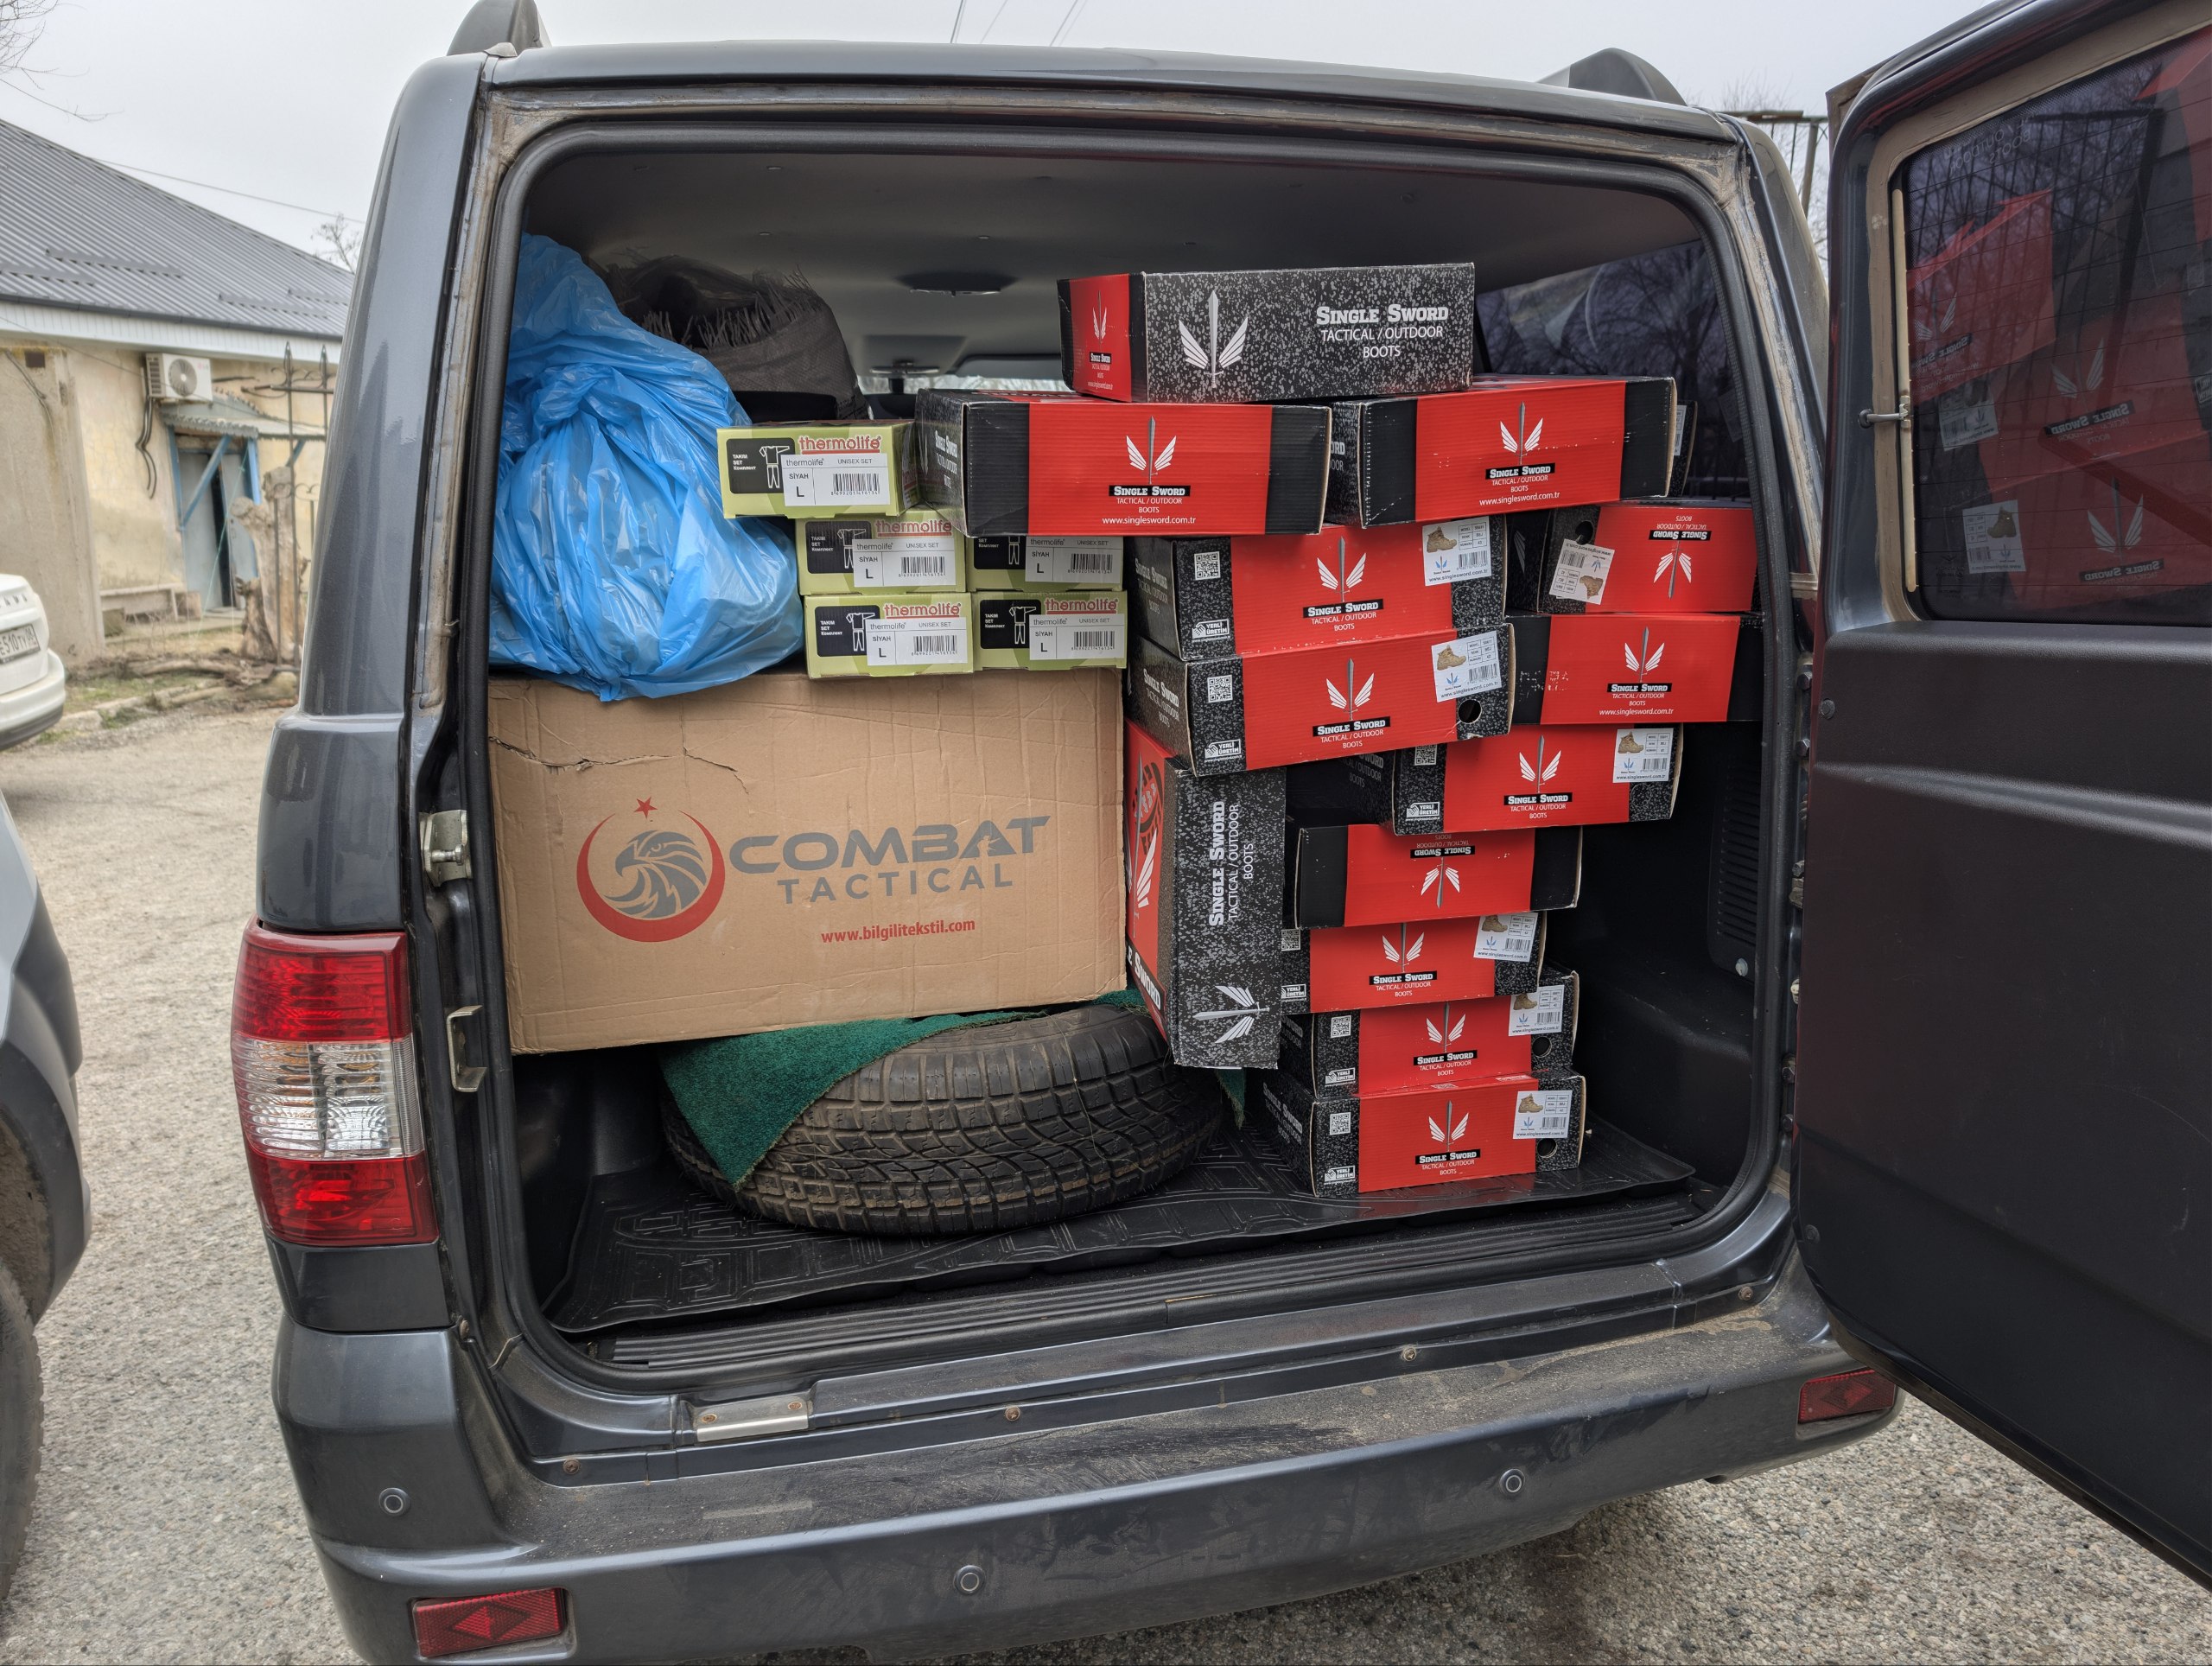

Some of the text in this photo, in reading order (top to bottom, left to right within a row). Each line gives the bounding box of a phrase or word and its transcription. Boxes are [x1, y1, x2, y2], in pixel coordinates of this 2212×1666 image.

[1316, 303, 1449, 325] SINGLE SWORD
[1321, 328, 1375, 341] TACTICAL
[1385, 326, 1443, 340] OUTDOOR
[1363, 346, 1401, 358] BOOTS
[1490, 466, 1551, 478] SINGLE SWORD
[797, 486, 804, 498] L
[1114, 486, 1185, 496] SINGLE SWORD
[1479, 492, 1560, 506] www.singlesword.com.tr
[1102, 516, 1197, 525] www.singlesword.com.tr
[1653, 531, 1707, 540] SINGLE SWORD
[866, 569, 874, 579] L
[1037, 563, 1044, 574] L
[1429, 569, 1488, 582] www.singlesword.com.tr
[1308, 602, 1379, 617] SINGLE SWORD
[1312, 616, 1340, 625] TACTICAL
[1345, 612, 1376, 621] OUTDOOR
[879, 648, 887, 658] L
[1040, 643, 1047, 652] L
[1143, 668, 1179, 707] SINGLE SWORD
[1441, 682, 1498, 698] www.singlesword.com.tr
[1318, 720, 1386, 735] SINGLE SWORD
[1320, 734, 1348, 742] TACTICAL
[1353, 729, 1383, 739] OUTDOOR
[1508, 794, 1568, 804] SINGLE SWORD
[1228, 804, 1239, 861] OUTDOOR
[729, 816, 1051, 874] COMBAT
[1209, 801, 1225, 925] SINGLE SWORD
[1243, 843, 1253, 880] BOOTS
[778, 863, 1014, 905] TACTICAL
[1228, 869, 1238, 920] TACTICAL
[821, 918, 976, 943] www.bilgilitekstil.com
[1374, 973, 1433, 984] SINGLE SWORD
[1446, 1052, 1474, 1061] SWORD
[1449, 1151, 1477, 1160] SWORD
